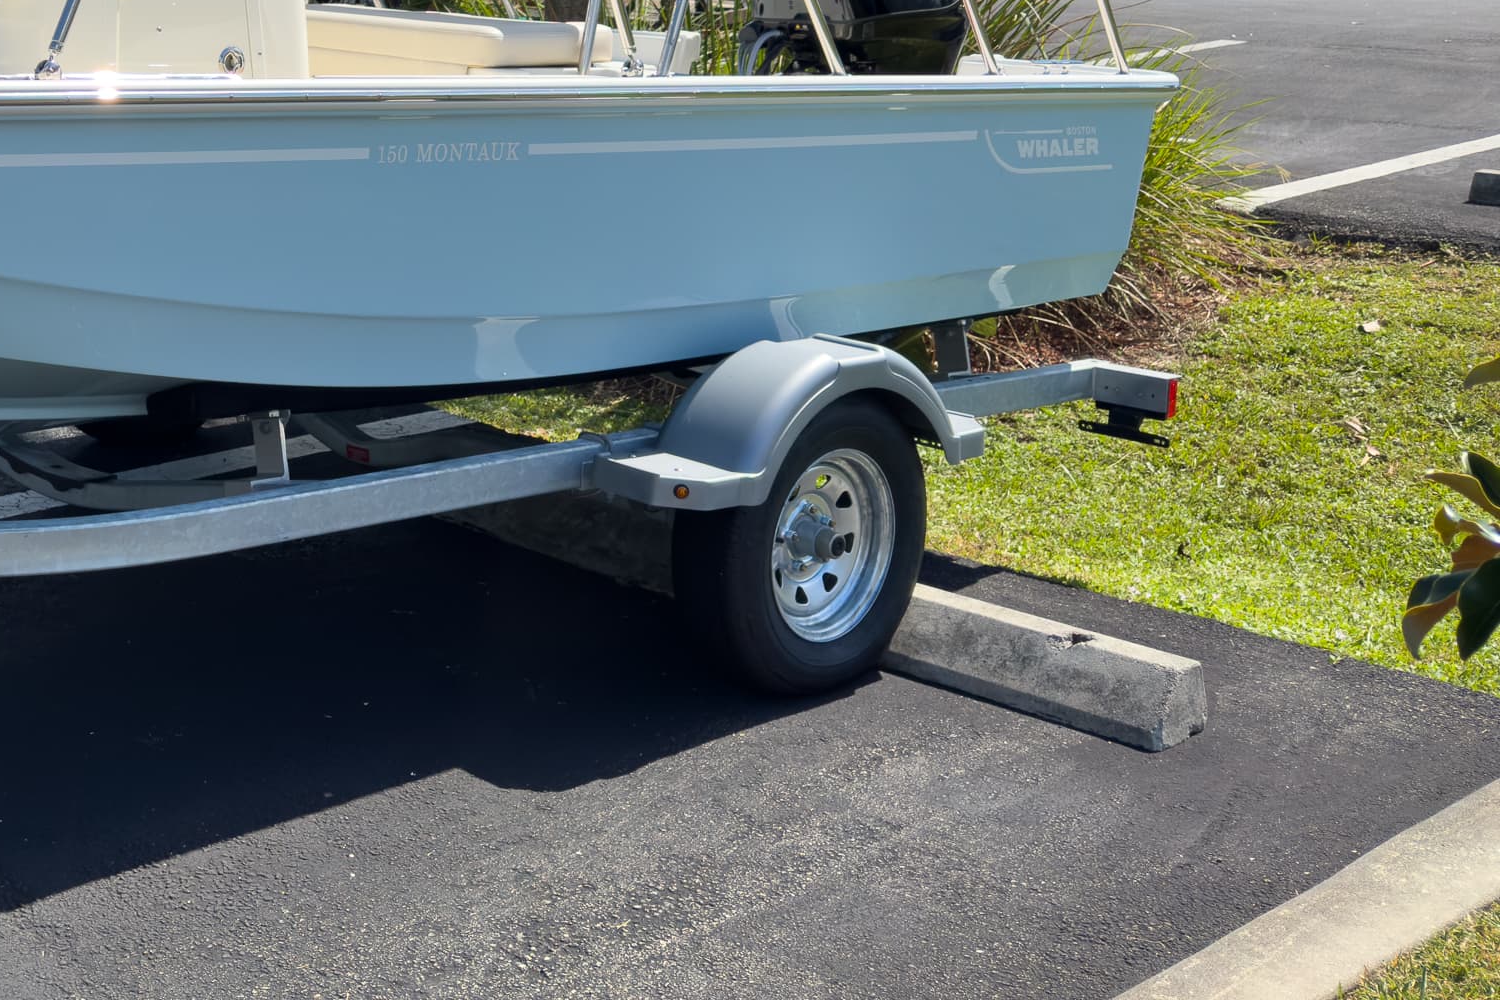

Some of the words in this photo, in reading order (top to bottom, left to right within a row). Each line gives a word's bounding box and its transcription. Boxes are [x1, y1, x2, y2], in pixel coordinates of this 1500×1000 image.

[1066, 126, 1097, 136] BOSTON
[379, 145, 408, 164] 150
[416, 142, 521, 163] MONTAUK
[1017, 138, 1099, 158] WHALER
